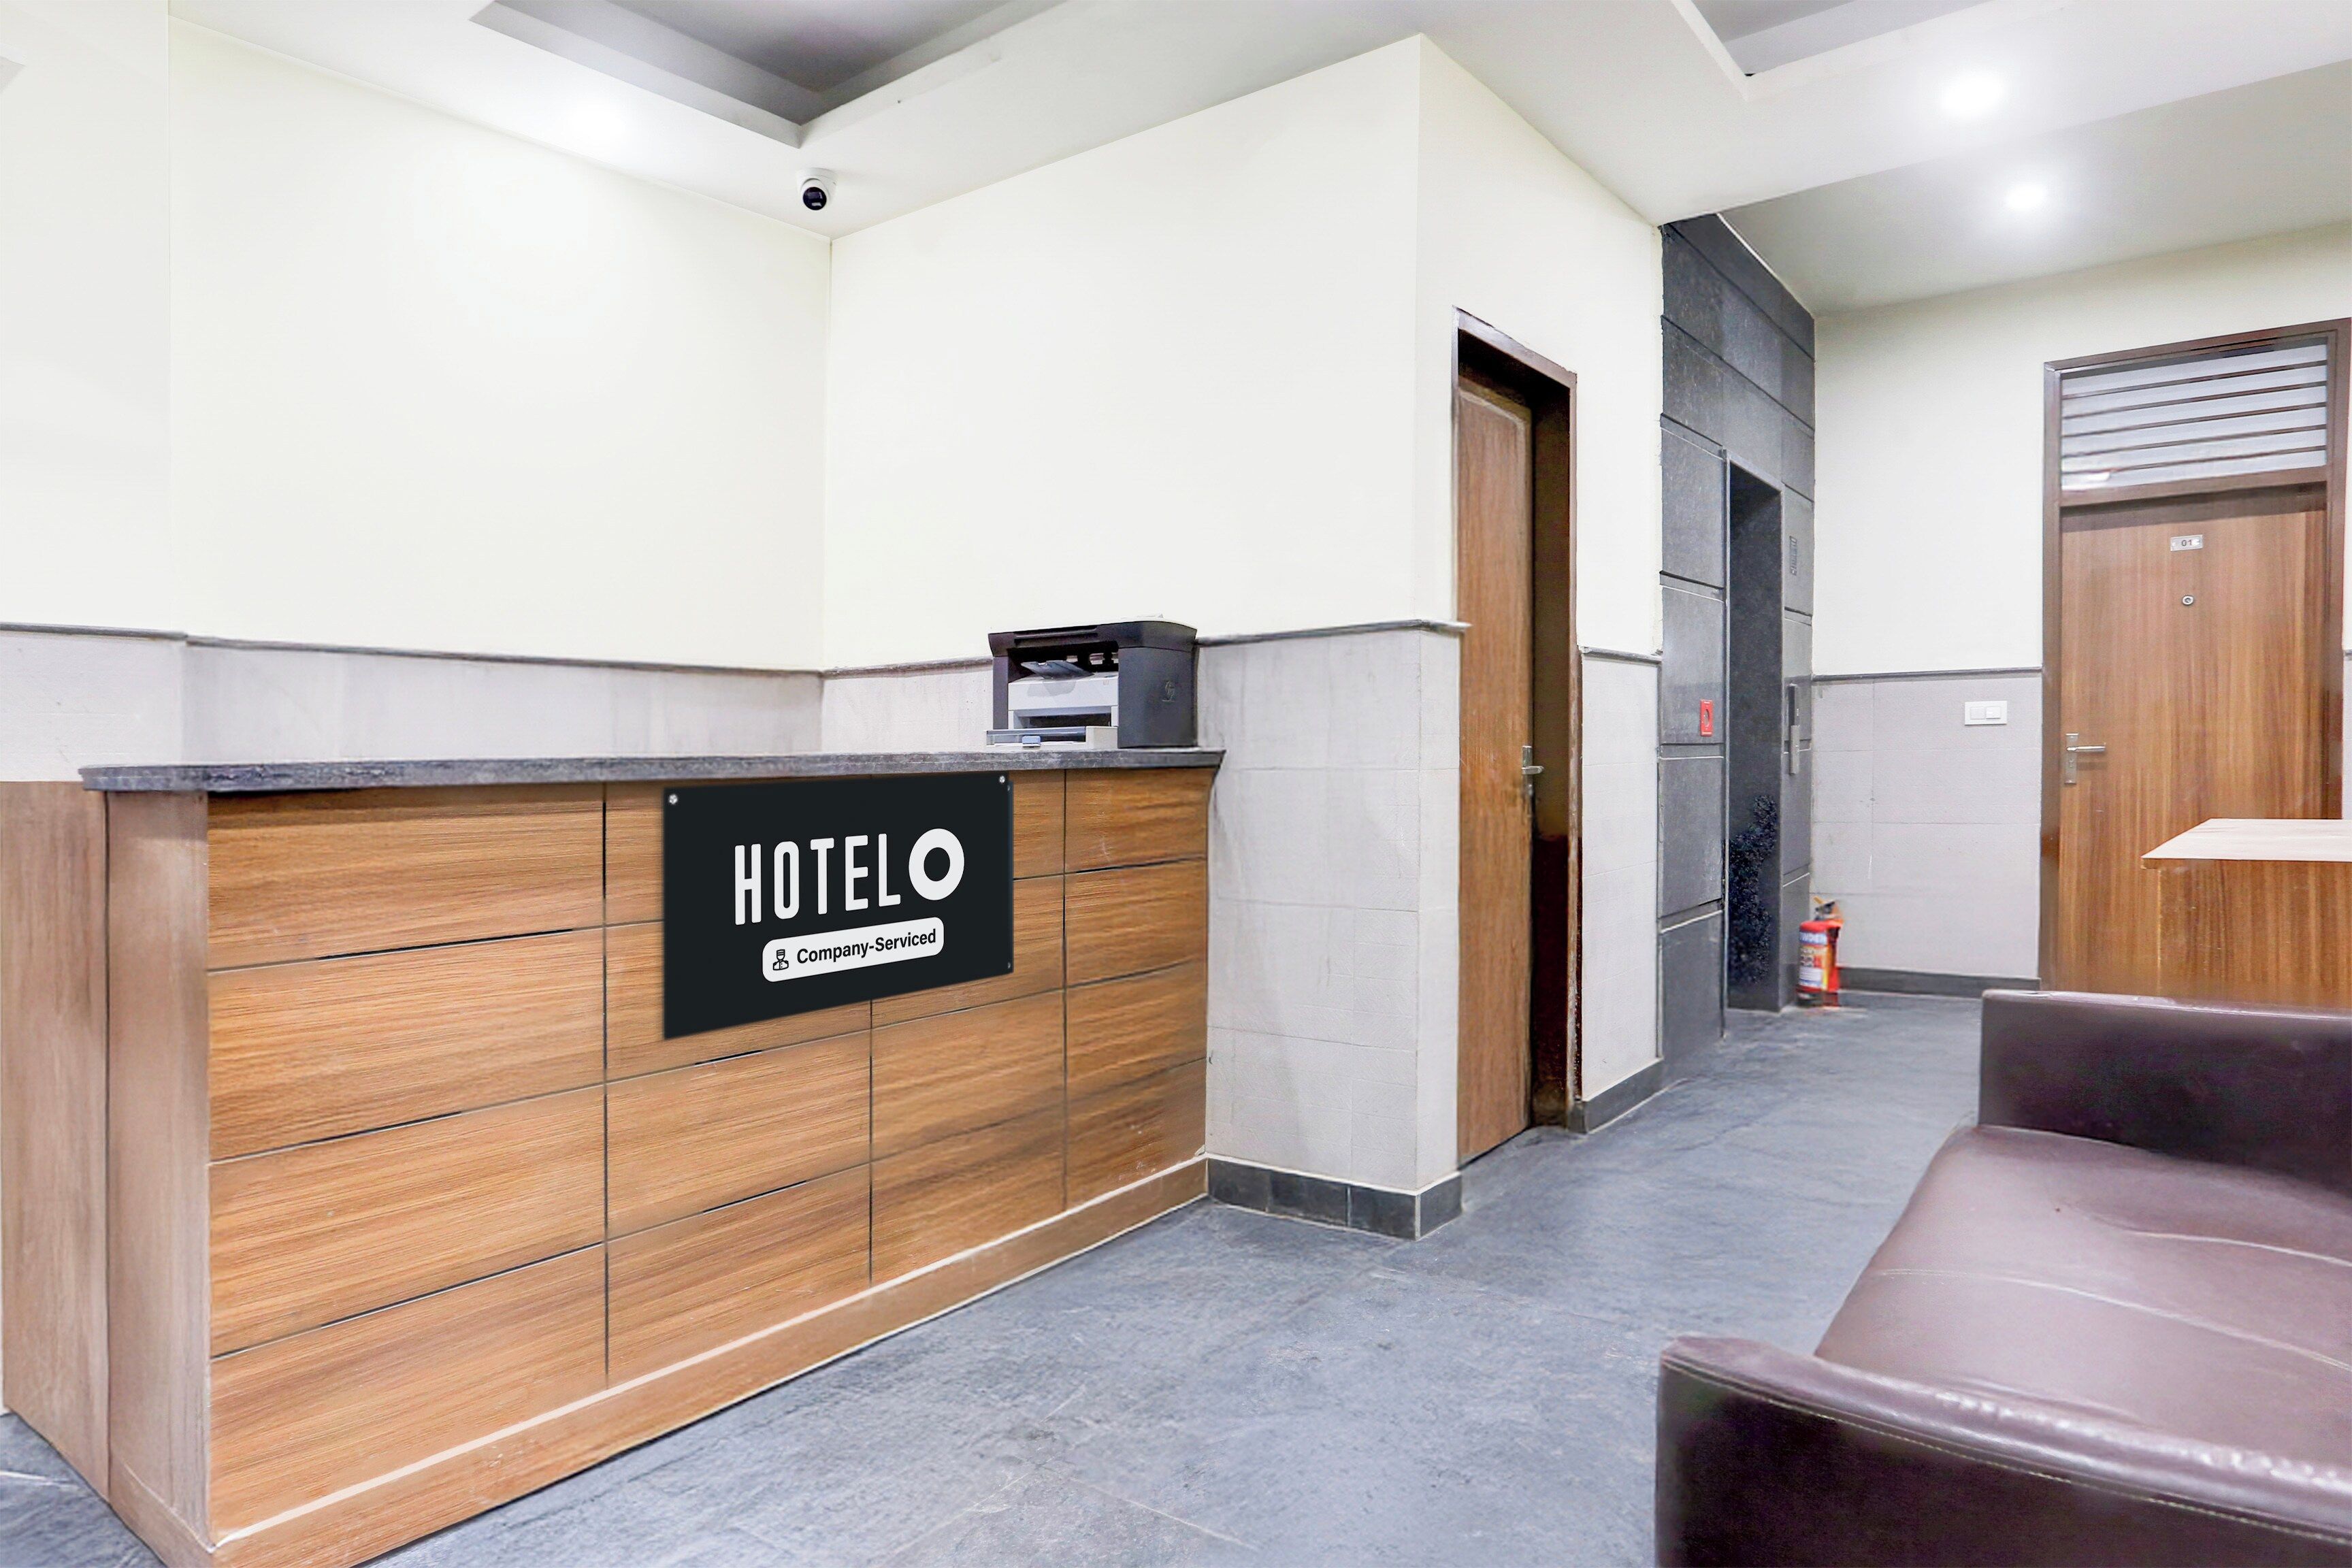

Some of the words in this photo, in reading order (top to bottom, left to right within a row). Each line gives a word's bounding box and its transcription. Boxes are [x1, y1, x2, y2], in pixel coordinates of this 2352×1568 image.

[734, 833, 901, 926] HOTEL
[909, 828, 965, 901] O
[796, 928, 936, 964] Company-Serviced
